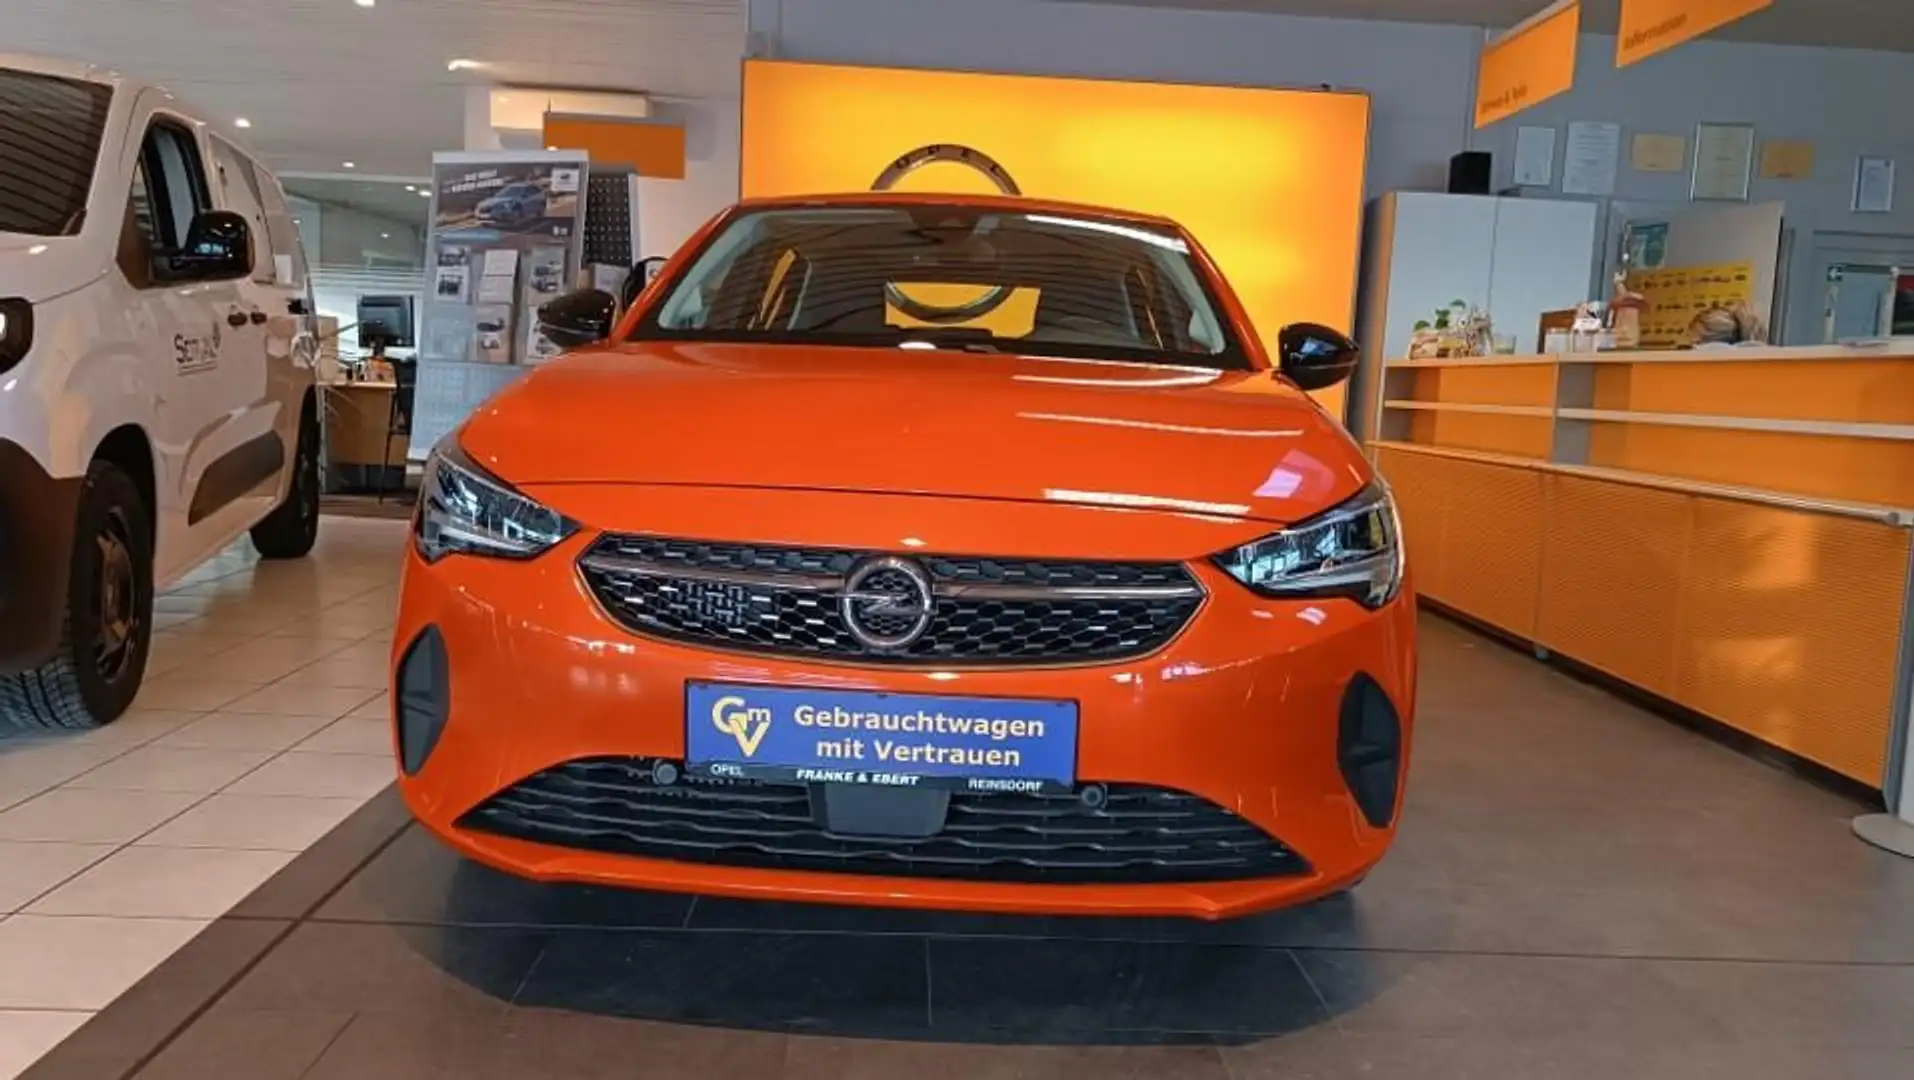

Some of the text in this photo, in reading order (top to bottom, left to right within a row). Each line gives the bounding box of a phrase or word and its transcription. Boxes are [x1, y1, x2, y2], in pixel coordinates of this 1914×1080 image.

[794, 705, 1045, 740] Gebrauchtwagen
[816, 737, 1020, 767] mit Vertrauen
[710, 763, 745, 777] OPEL
[796, 769, 920, 786] FRANKE & EBERT
[967, 777, 1043, 792] REINSDORF
